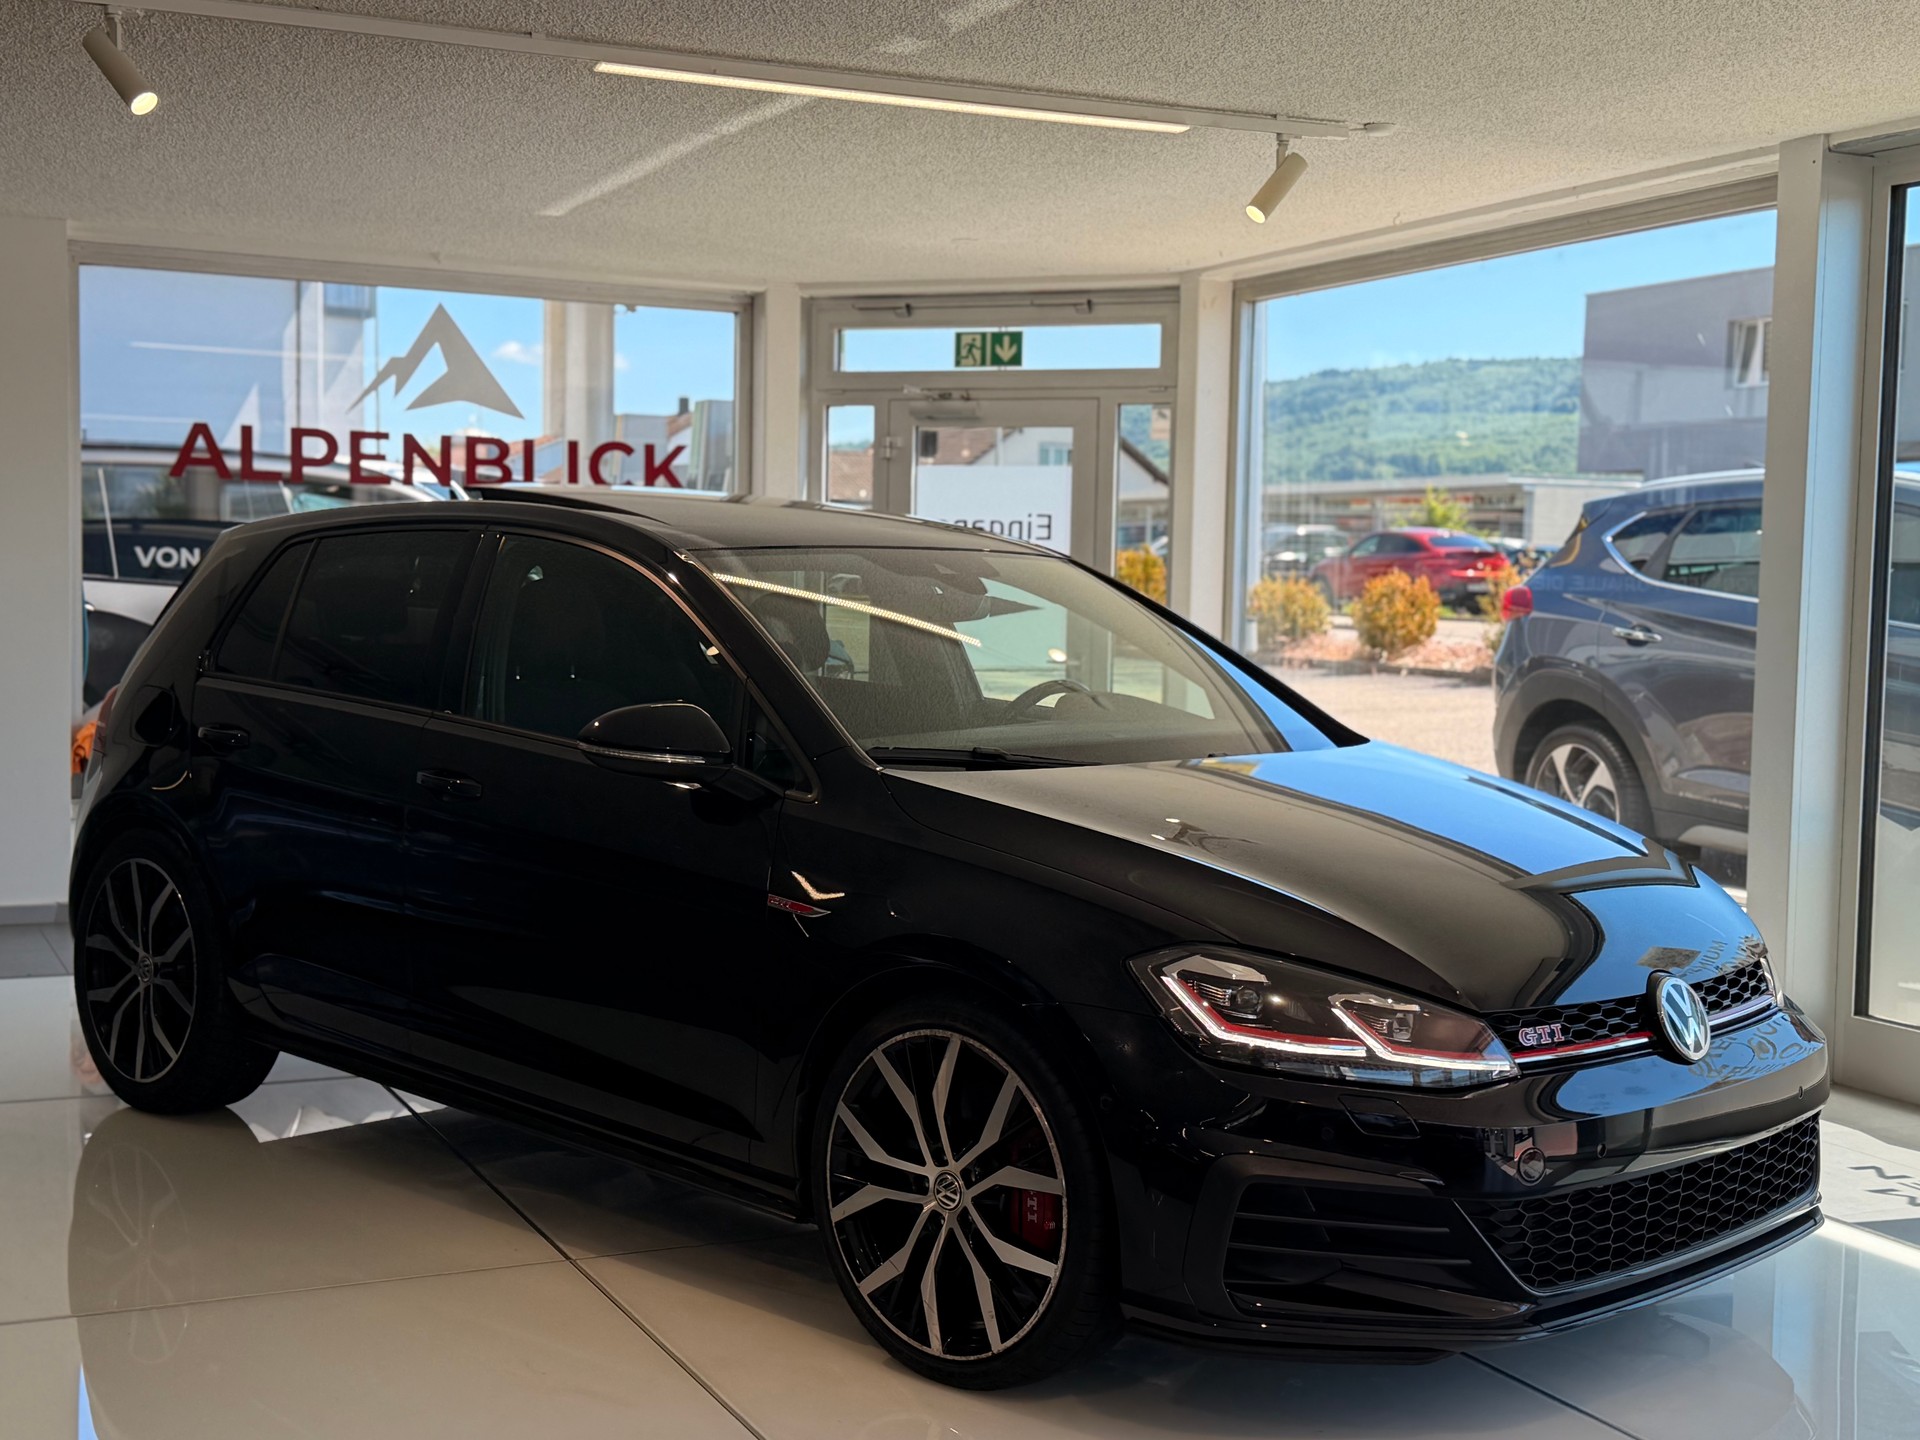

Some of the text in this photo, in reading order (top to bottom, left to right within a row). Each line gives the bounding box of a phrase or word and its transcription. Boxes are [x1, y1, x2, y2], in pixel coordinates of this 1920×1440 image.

[133, 545, 201, 569] VON
[1518, 1023, 1564, 1047] GTI
[1026, 1190, 1038, 1224] TI
